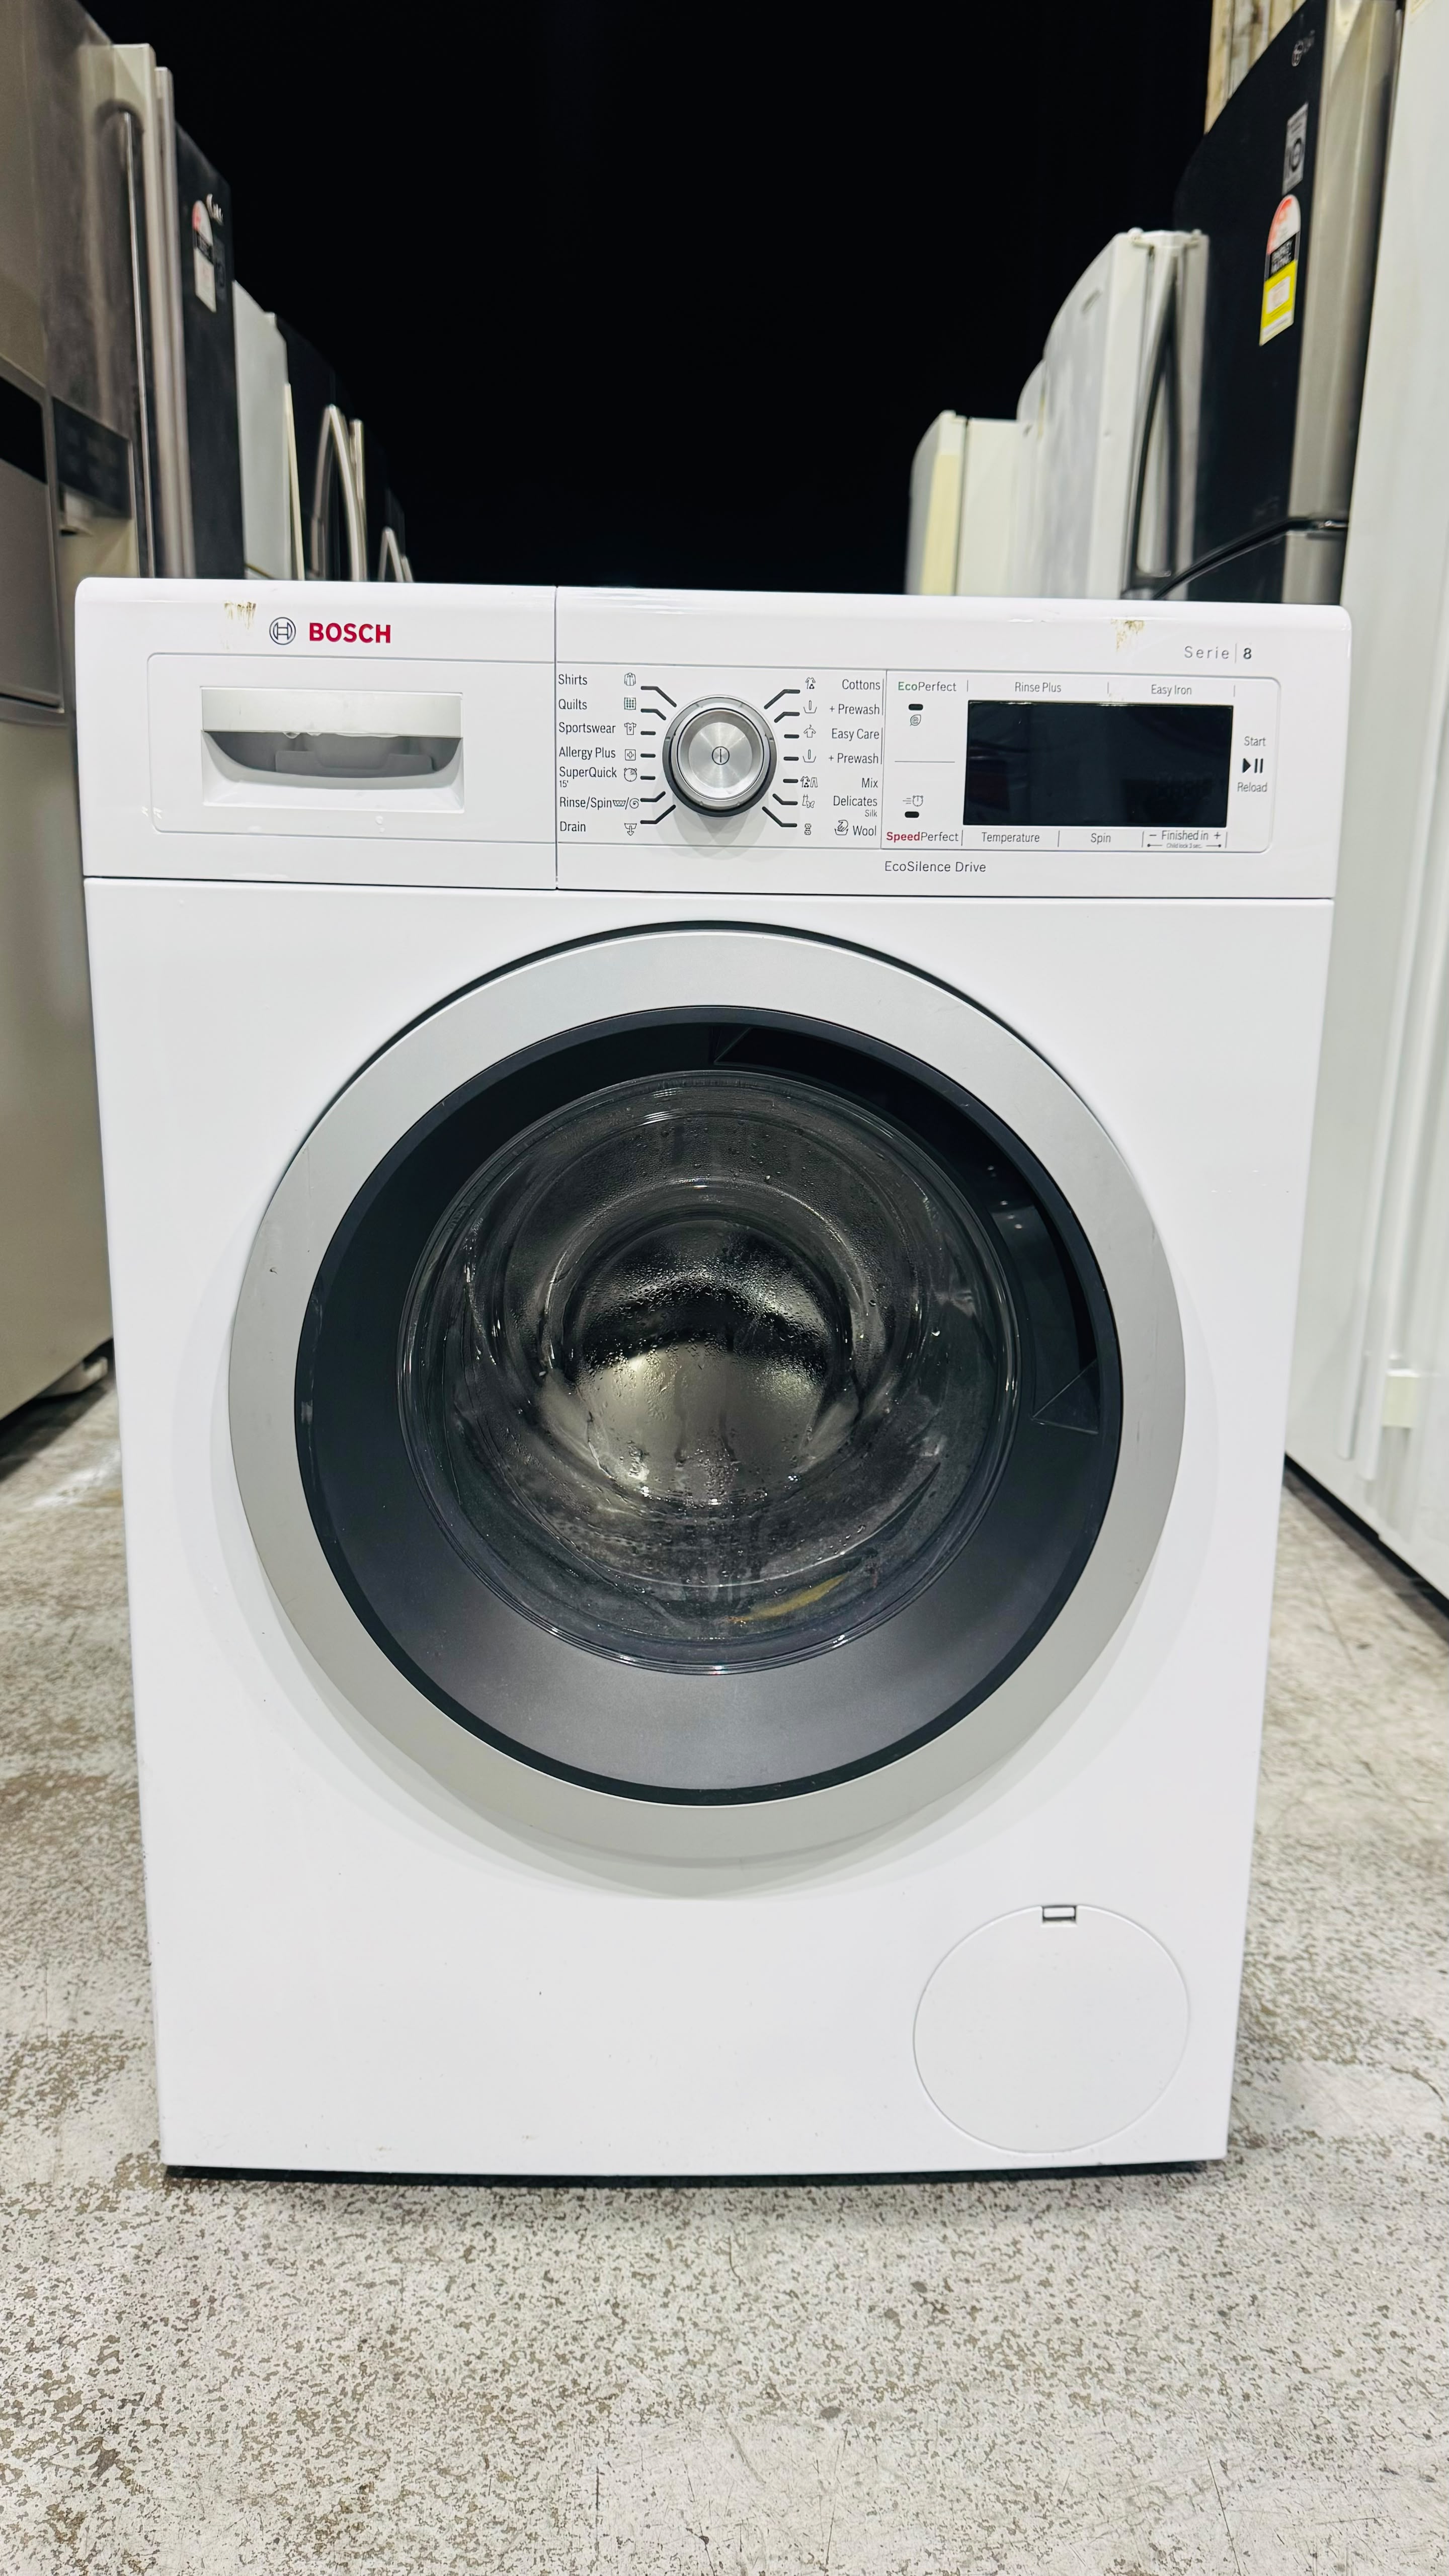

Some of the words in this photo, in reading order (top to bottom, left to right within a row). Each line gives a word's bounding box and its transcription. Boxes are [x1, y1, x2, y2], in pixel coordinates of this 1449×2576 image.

[309, 622, 391, 643] BOSCH
[1184, 646, 1229, 659] Serie
[1243, 648, 1252, 660] 8
[558, 673, 588, 685] Shirts
[842, 679, 880, 690] Cottons
[898, 681, 956, 692] EcoPerfect
[1015, 682, 1040, 692] Rinse
[1042, 682, 1062, 693] Plus
[1151, 684, 1172, 697] Easy
[1174, 685, 1192, 695] Iron
[558, 698, 587, 710] Quilts
[838, 703, 880, 715] Prewash
[558, 721, 616, 735] Sportswear
[832, 728, 854, 742] Easy
[856, 728, 879, 740] Care
[1244, 736, 1266, 747] Start
[558, 746, 593, 760] Allergy
[595, 747, 616, 758] Plus
[837, 753, 878, 764] Prewash
[559, 766, 617, 779] SuperQuick
[861, 777, 878, 788] Mix
[1237, 782, 1267, 792] Reload
[559, 796, 612, 811] Rinse/Spin
[833, 795, 877, 807] Delicates
[864, 809, 877, 817] Silk
[560, 821, 586, 832] Drain
[852, 825, 876, 836] Wool
[886, 831, 958, 843] SpeedPerfect
[981, 832, 1040, 844] Temperature
[1090, 833, 1111, 845] Spin
[1161, 830, 1199, 840] Finished
[1200, 830, 1209, 840] in
[885, 861, 951, 872] EcoSilence
[955, 861, 986, 872] Drive
